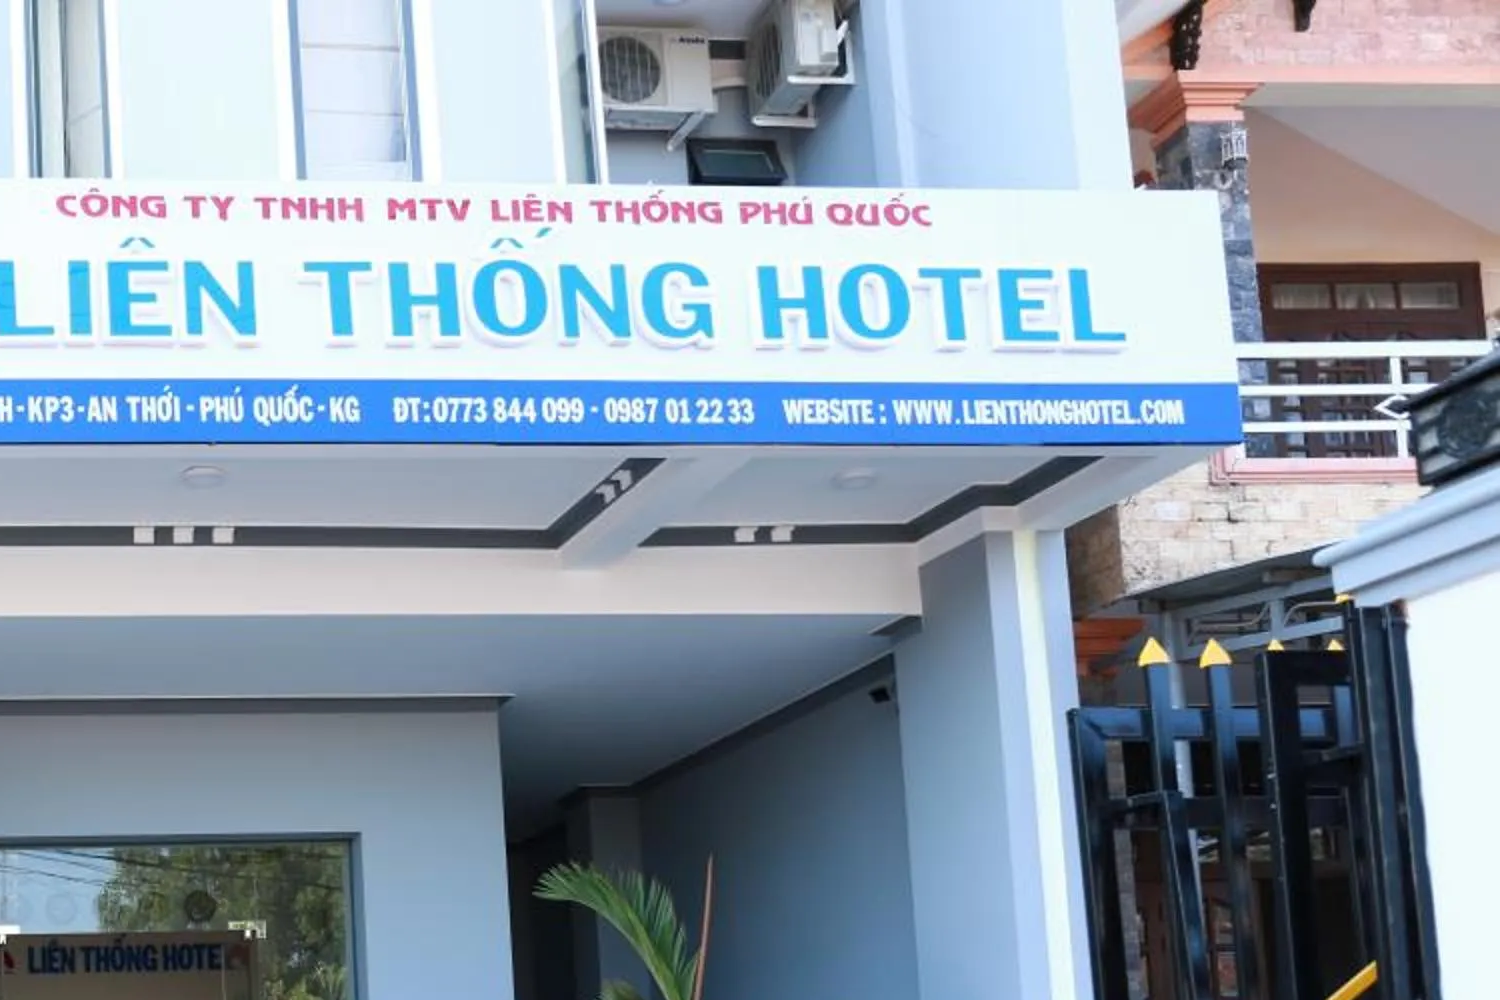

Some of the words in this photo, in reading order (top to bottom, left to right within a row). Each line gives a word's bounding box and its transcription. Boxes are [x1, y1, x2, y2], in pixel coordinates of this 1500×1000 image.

[57, 187, 167, 219] CÔNG
[184, 196, 235, 221] TY
[254, 197, 364, 222] TNHH
[387, 198, 471, 222] MTV
[491, 193, 573, 224] LIÊN
[590, 189, 723, 225] THỐNG
[740, 195, 813, 226] PHÚ
[826, 193, 932, 227] QUỐC
[302, 227, 716, 340] THỐNG
[756, 263, 1127, 342] HOTEL
[199, 387, 244, 423] PHÚ
[493, 397, 537, 424] 844
[541, 397, 585, 424] 099
[603, 397, 659, 424] 0987
